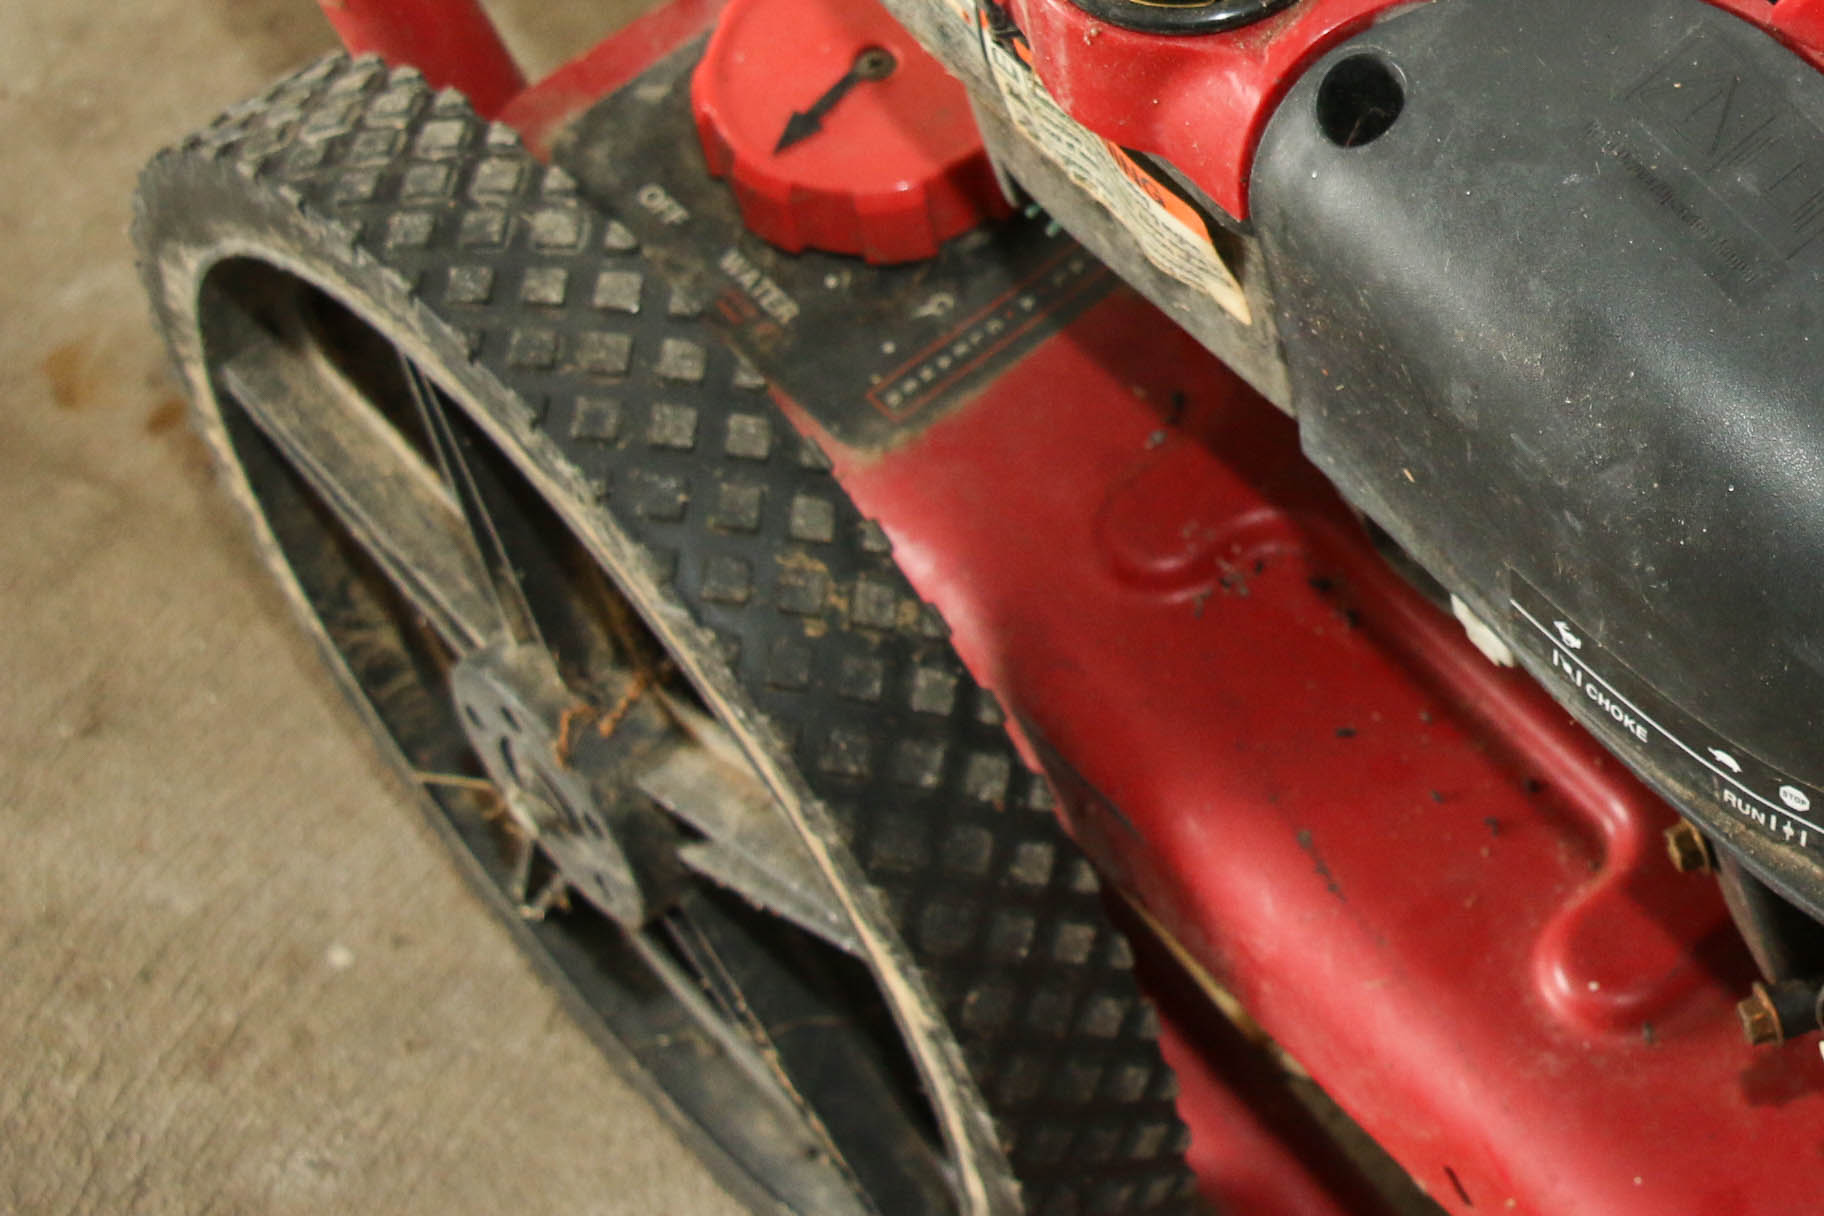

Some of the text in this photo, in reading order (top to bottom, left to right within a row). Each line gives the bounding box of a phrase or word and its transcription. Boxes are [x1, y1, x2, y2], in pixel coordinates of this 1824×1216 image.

[637, 182, 690, 226] OFF
[1586, 684, 1648, 743] CHOKE
[1722, 788, 1766, 826] RUN
